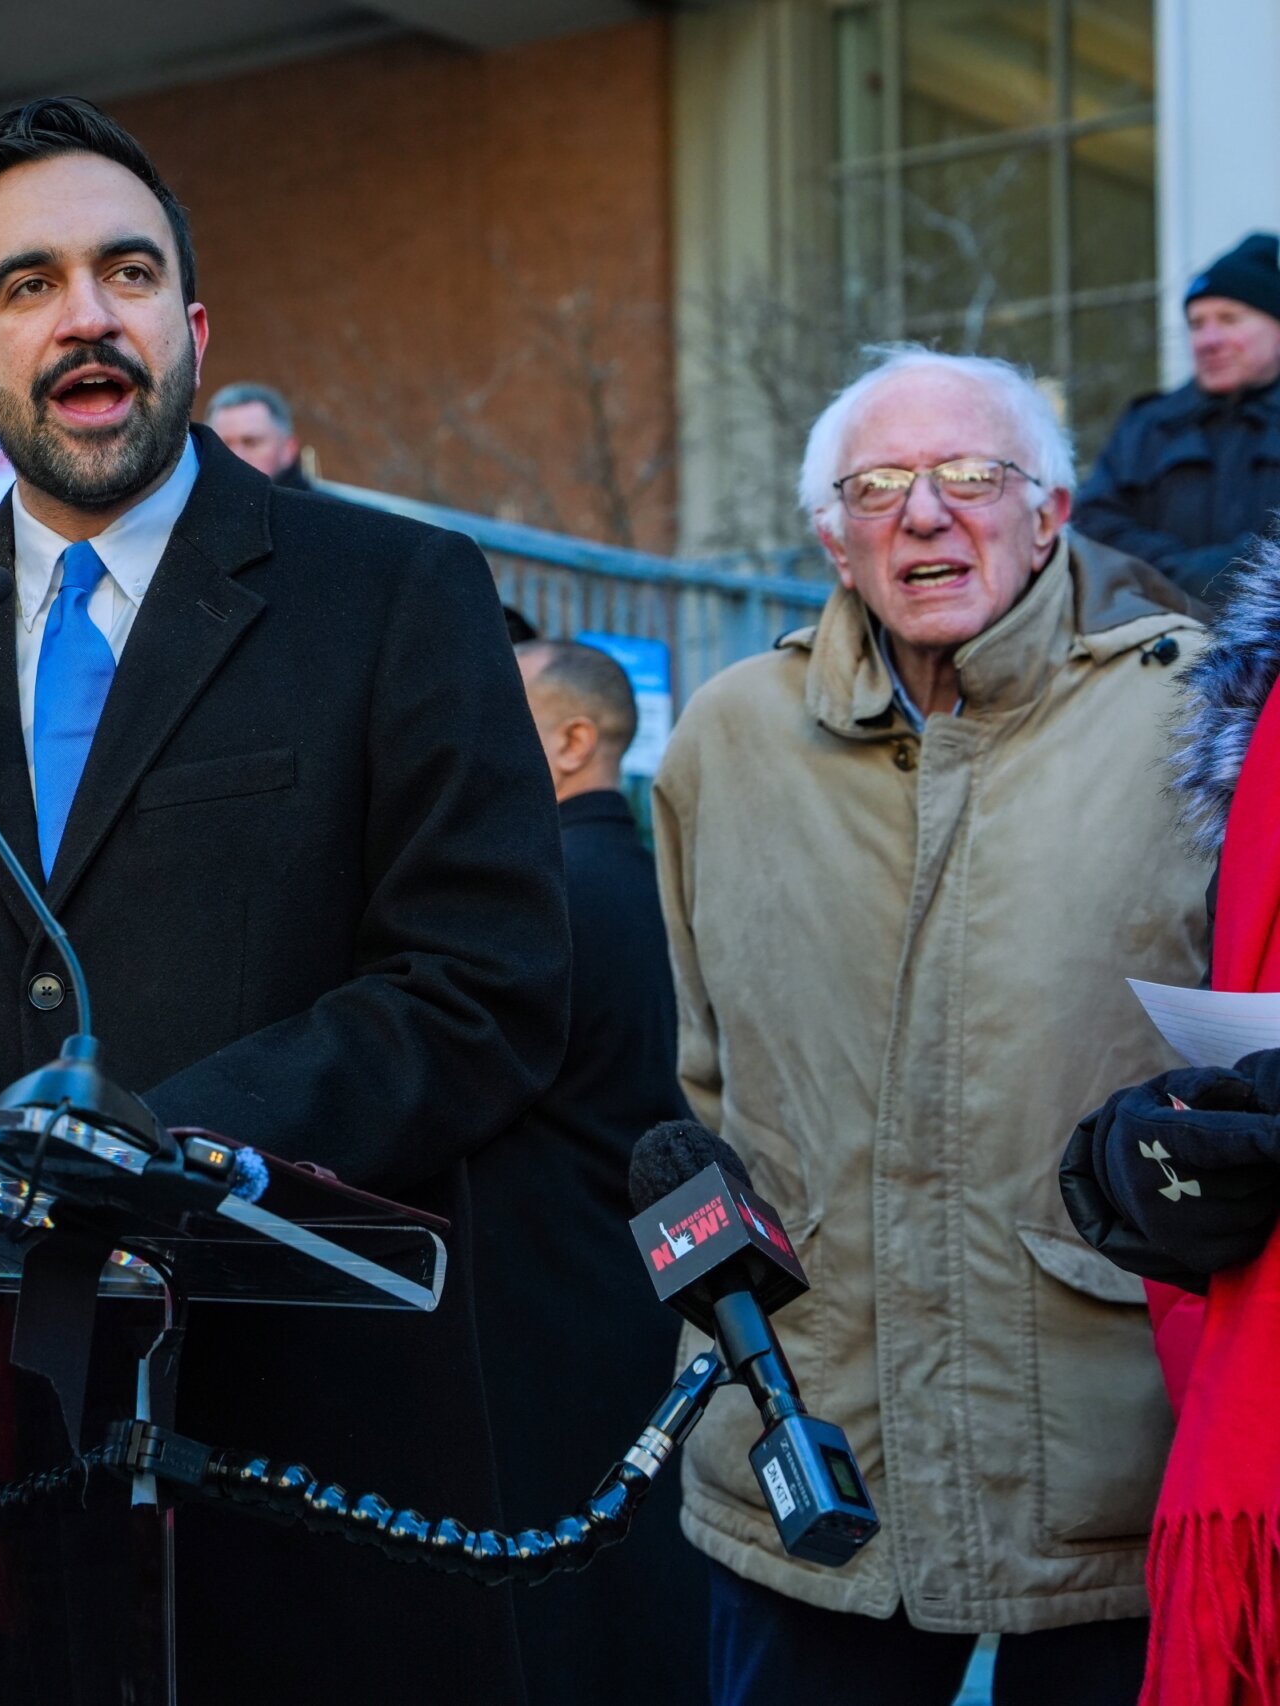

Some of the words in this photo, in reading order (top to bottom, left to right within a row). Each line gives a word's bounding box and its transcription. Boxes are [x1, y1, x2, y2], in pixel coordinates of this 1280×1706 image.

[669, 1195, 724, 1237] DEMOCRACY
[766, 1463, 779, 1483] DN
[774, 1483, 789, 1504] KIT
